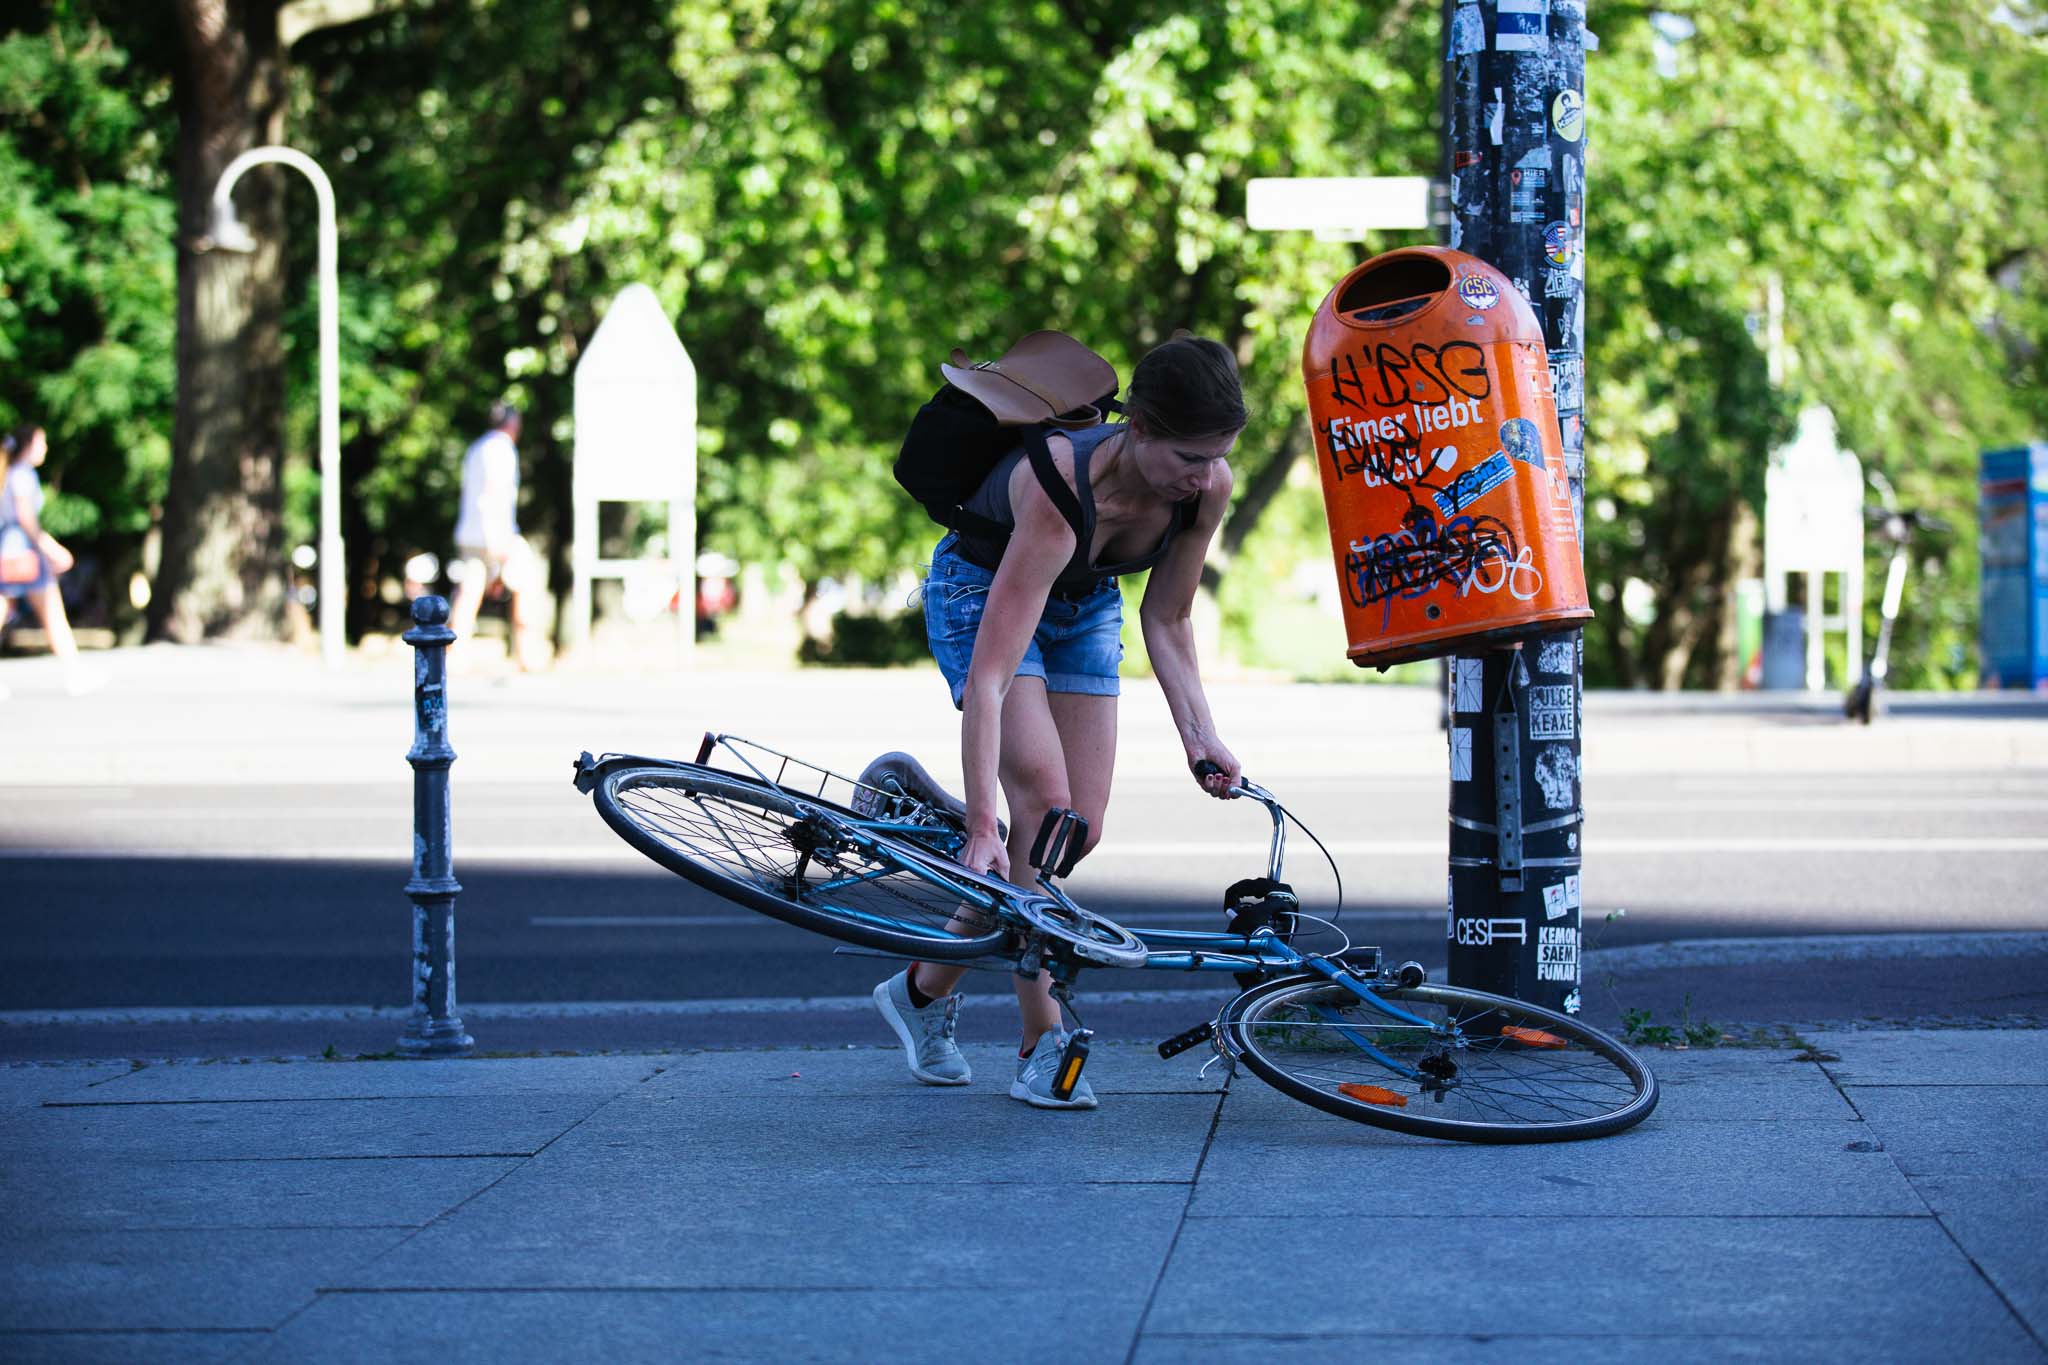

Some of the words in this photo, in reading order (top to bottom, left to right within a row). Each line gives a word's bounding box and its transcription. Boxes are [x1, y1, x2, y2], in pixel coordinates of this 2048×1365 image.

[1523, 169, 1545, 177] HIER
[1465, 278, 1492, 295] CSC
[1331, 412, 1407, 452] Eimer
[1413, 395, 1483, 434] liebt
[1364, 448, 1422, 488] dich
[1531, 713, 1572, 731] KEAXE
[1542, 945, 1574, 962] SAEM
[1537, 962, 1576, 981] FUMAR
